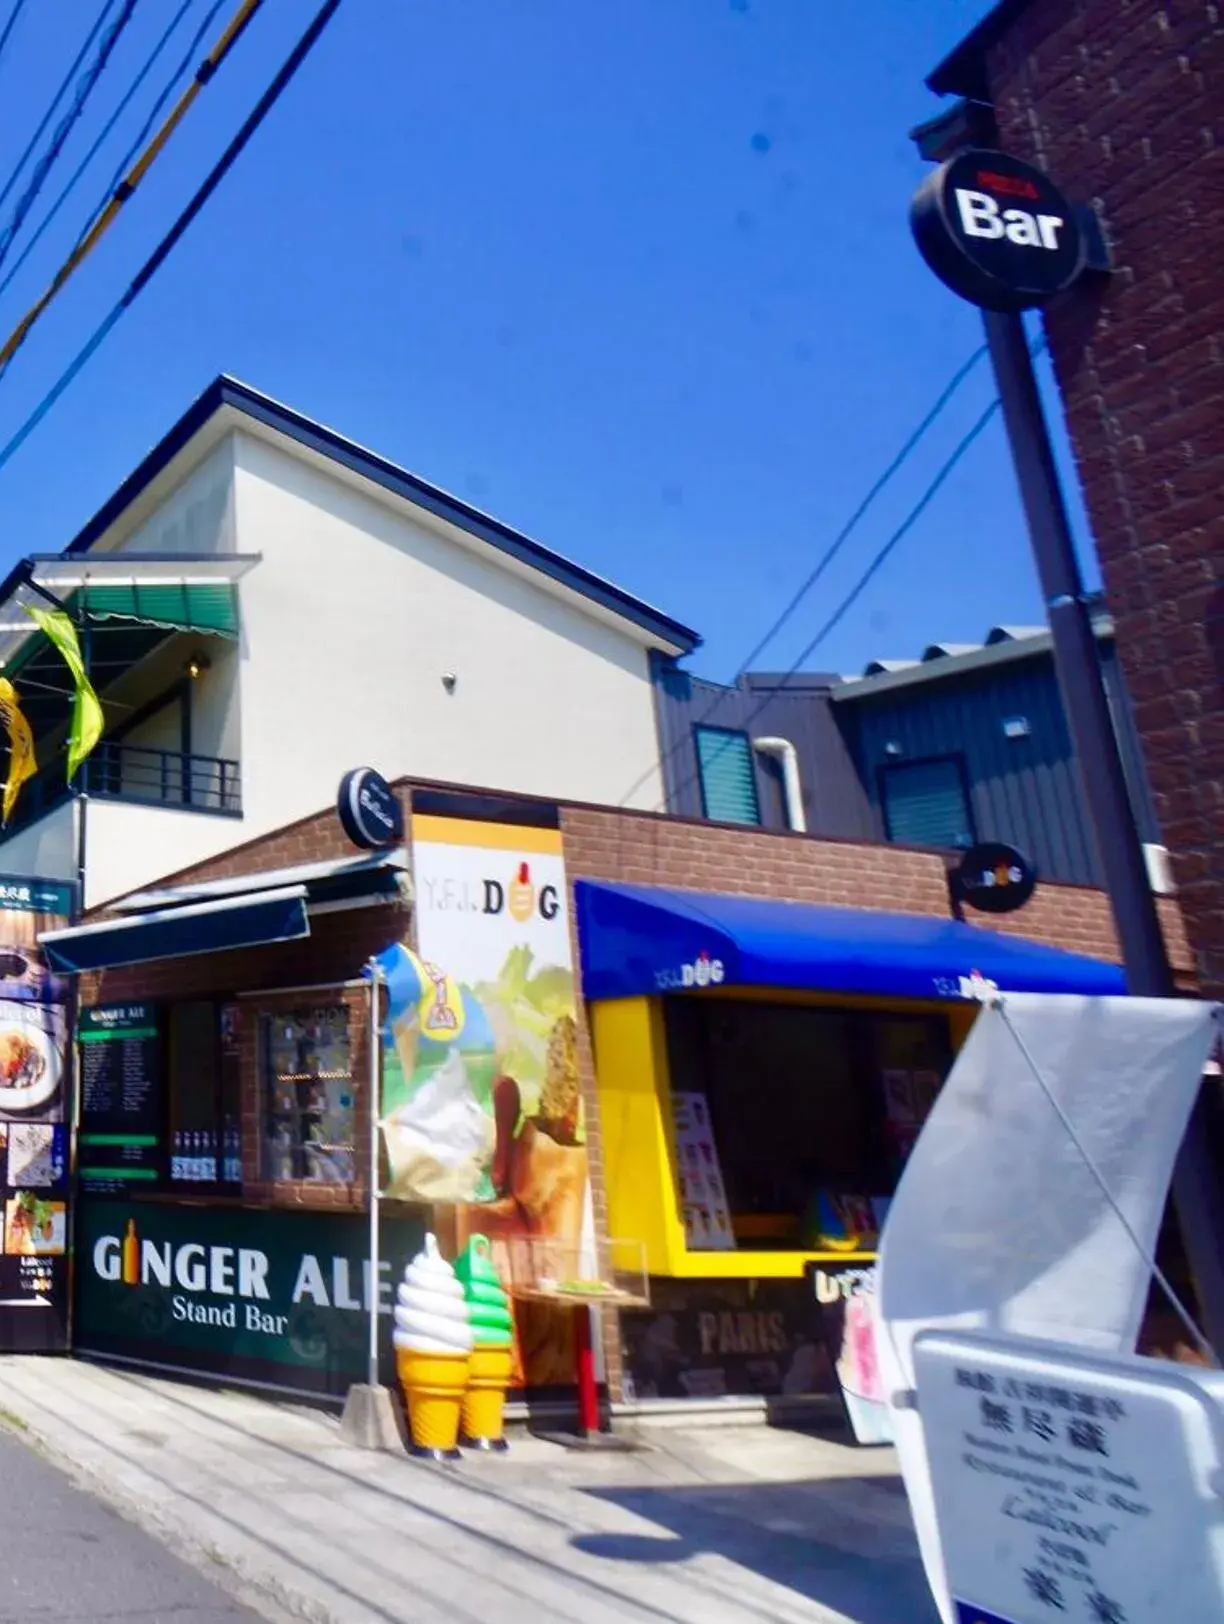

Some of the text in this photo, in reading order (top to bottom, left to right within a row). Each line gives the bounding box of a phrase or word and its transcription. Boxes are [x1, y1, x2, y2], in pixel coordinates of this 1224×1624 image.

[954, 187, 1064, 250] Bar
[93, 1234, 392, 1314] GINGER ALE
[172, 1296, 289, 1336] Stand Bar
